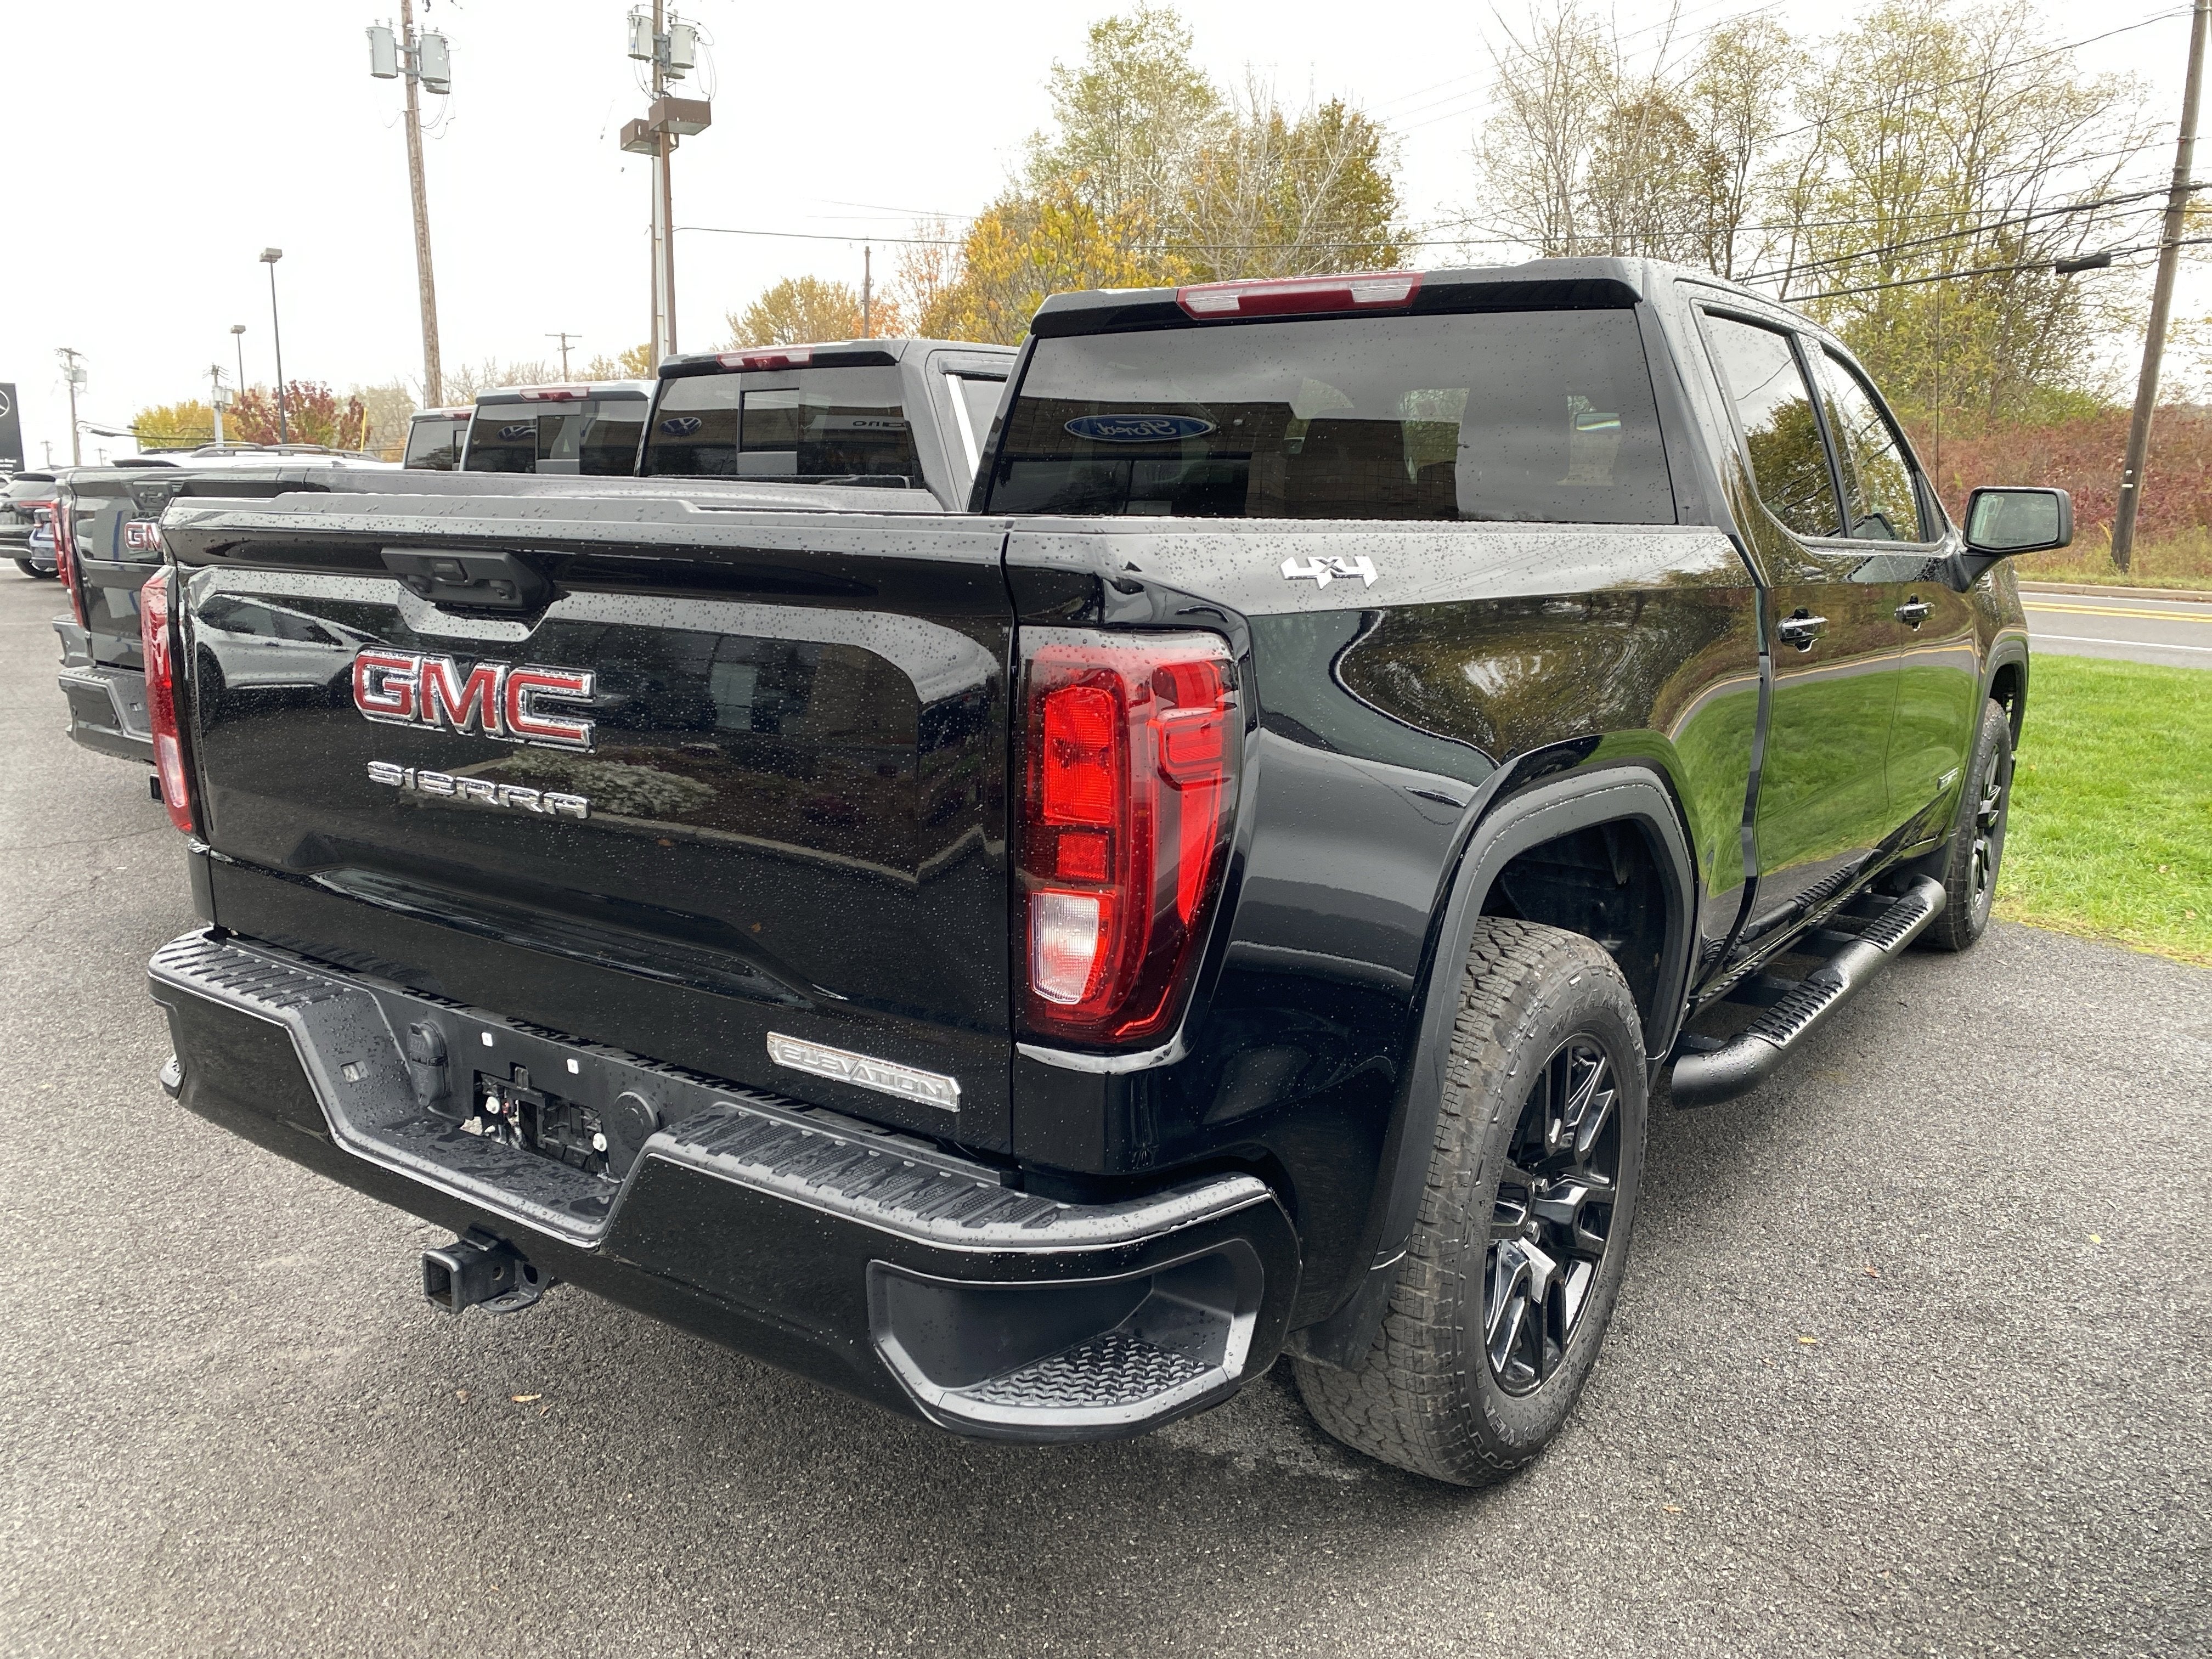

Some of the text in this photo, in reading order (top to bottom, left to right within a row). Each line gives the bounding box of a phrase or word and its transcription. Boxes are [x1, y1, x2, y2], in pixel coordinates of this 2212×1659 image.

[125, 522, 163, 552] GM
[353, 649, 597, 755] GMC
[367, 760, 591, 820] SIERRA
[780, 1043, 943, 1099] ELEVATION
